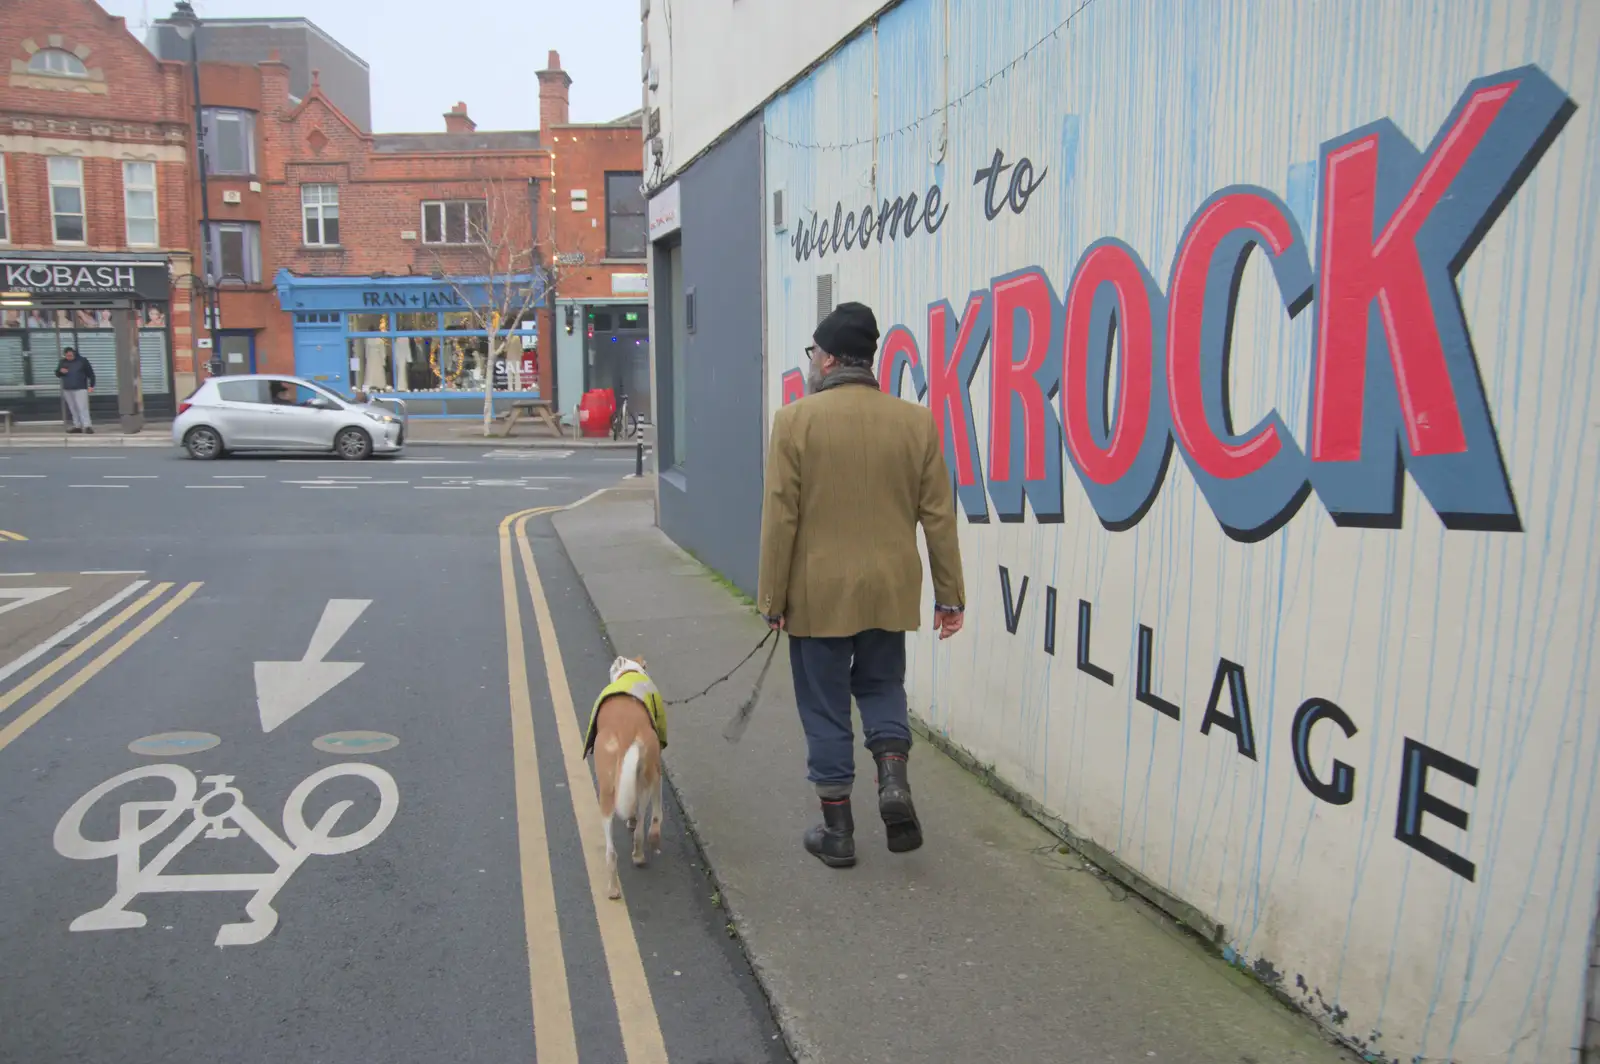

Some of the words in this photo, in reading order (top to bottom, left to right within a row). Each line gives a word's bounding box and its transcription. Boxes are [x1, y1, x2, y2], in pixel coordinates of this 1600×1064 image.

[791, 184, 950, 263] welcome
[972, 147, 1048, 221] to
[6, 264, 136, 287] KOBASH
[362, 291, 406, 306] FRAN
[422, 291, 463, 308] JANE
[495, 360, 533, 374] SALE
[998, 565, 1480, 882] VILLAGE
